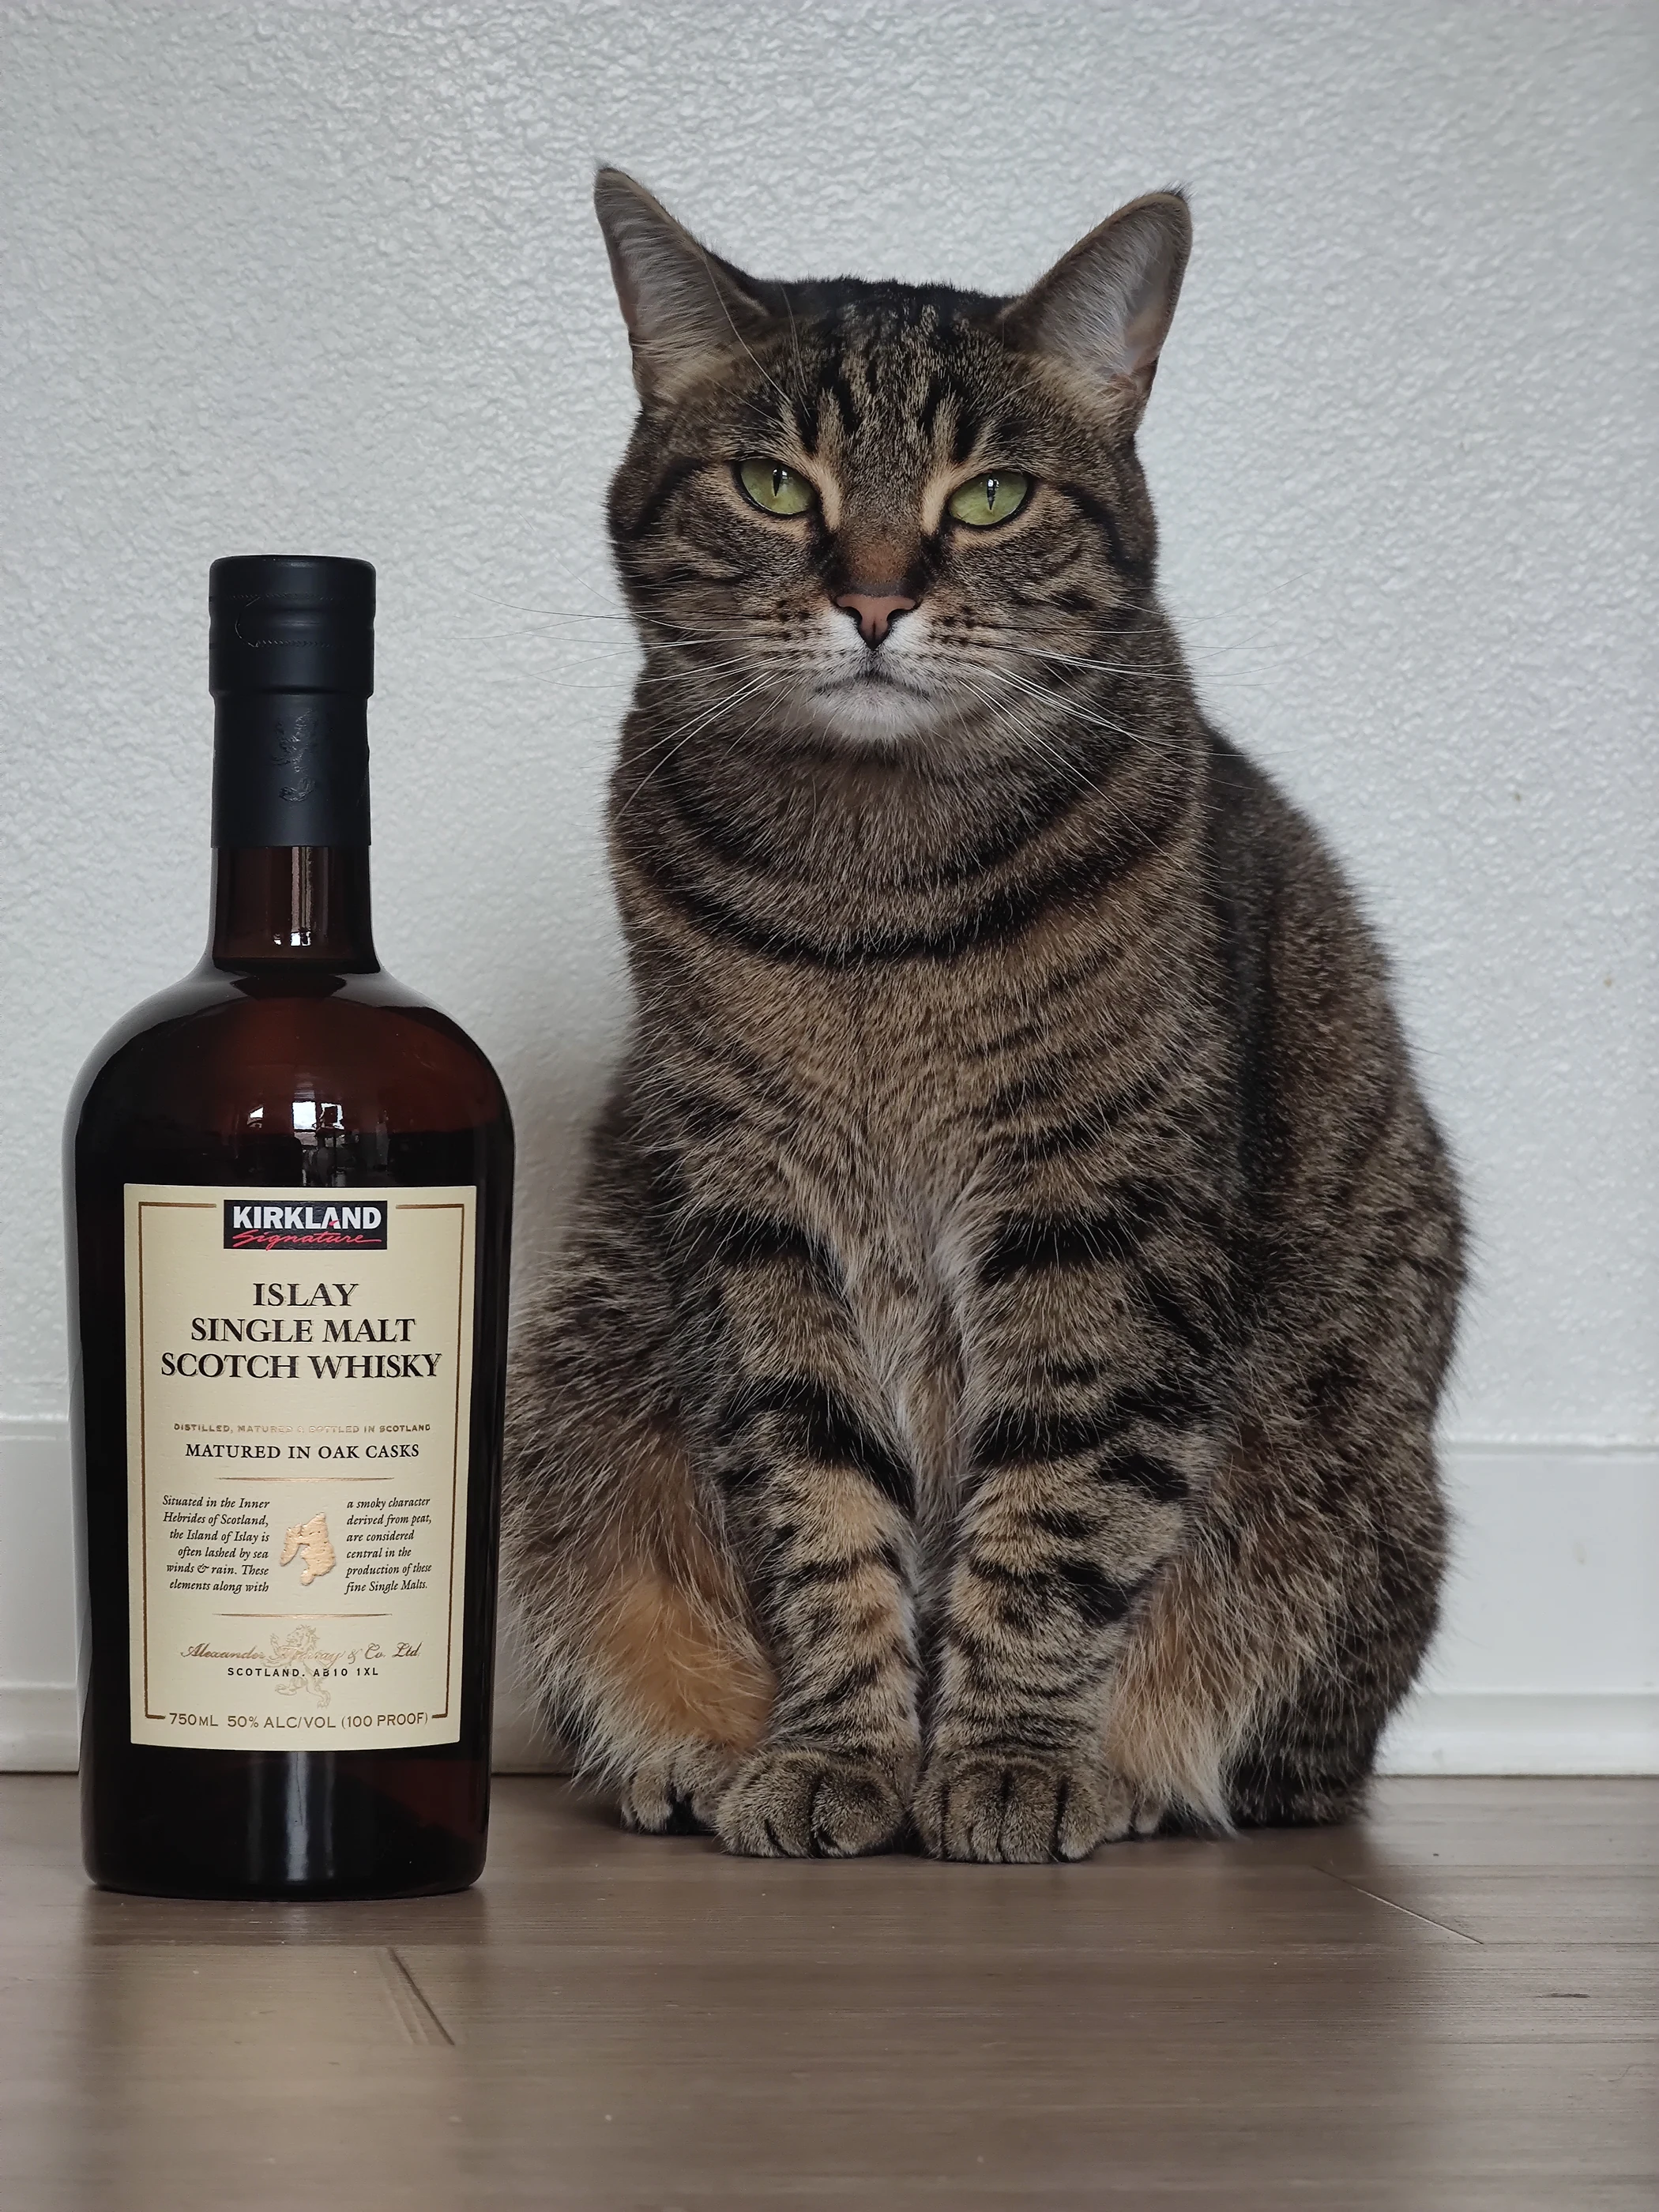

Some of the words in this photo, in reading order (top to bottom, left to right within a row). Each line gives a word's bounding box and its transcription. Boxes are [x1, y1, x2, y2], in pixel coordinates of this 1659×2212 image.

[233, 1206, 382, 1229] KIRKLAND
[232, 1229, 382, 1251] Signature
[253, 1283, 359, 1307] ISLAY
[191, 1317, 314, 1343] SINGLE
[322, 1319, 416, 1343] MALT
[161, 1352, 299, 1379] SCOTCH
[307, 1352, 442, 1379] WHISKY
[174, 1423, 233, 1433] DISTILLED,
[238, 1424, 293, 1433] MATURED
[379, 1424, 431, 1432] SCOTLAND
[185, 1443, 281, 1458] MATURED
[288, 1446, 310, 1459] IN
[318, 1445, 359, 1458] OAK
[366, 1444, 419, 1458] CASKS
[162, 1495, 203, 1507] Situated
[206, 1497, 217, 1507] in
[220, 1497, 235, 1508] the
[239, 1498, 269, 1508] Inner
[356, 1498, 386, 1510] smoky
[388, 1497, 431, 1507] character
[163, 1511, 205, 1524] Hebrides
[209, 1514, 220, 1526] of
[220, 1514, 269, 1527] Scotland,
[347, 1514, 384, 1525] derived
[385, 1514, 408, 1527] from
[411, 1514, 431, 1526] peat,
[170, 1529, 183, 1539] the
[186, 1529, 218, 1540] Island
[221, 1531, 233, 1544] of
[234, 1531, 258, 1544] Islay
[261, 1532, 269, 1542] is
[366, 1529, 415, 1541] considered
[178, 1546, 202, 1559] often
[205, 1547, 236, 1558] lashed
[239, 1548, 250, 1561] by
[346, 1548, 383, 1559] central
[385, 1547, 395, 1558] in
[398, 1546, 412, 1557] the
[167, 1562, 194, 1573] winds
[197, 1563, 209, 1573] &
[211, 1564, 237, 1574] rain.
[242, 1564, 269, 1575] These
[345, 1564, 399, 1578] production
[402, 1563, 412, 1576] of
[412, 1563, 432, 1573] these
[170, 1578, 211, 1590] elements
[213, 1581, 243, 1594] along
[245, 1582, 269, 1592] with
[344, 1582, 367, 1595] fine
[369, 1580, 398, 1593] Single
[401, 1579, 427, 1590] Malts.
[180, 1642, 265, 1659] Alexander
[348, 1648, 363, 1665] &
[365, 1642, 386, 1660] Co.
[228, 1668, 306, 1677] SCOTLAND.
[314, 1668, 348, 1677] AB10
[228, 1715, 259, 1729] 50%
[264, 1716, 336, 1729] ALC/VOL
[341, 1715, 372, 1729] (100
[377, 1712, 428, 1727] PROOF)
